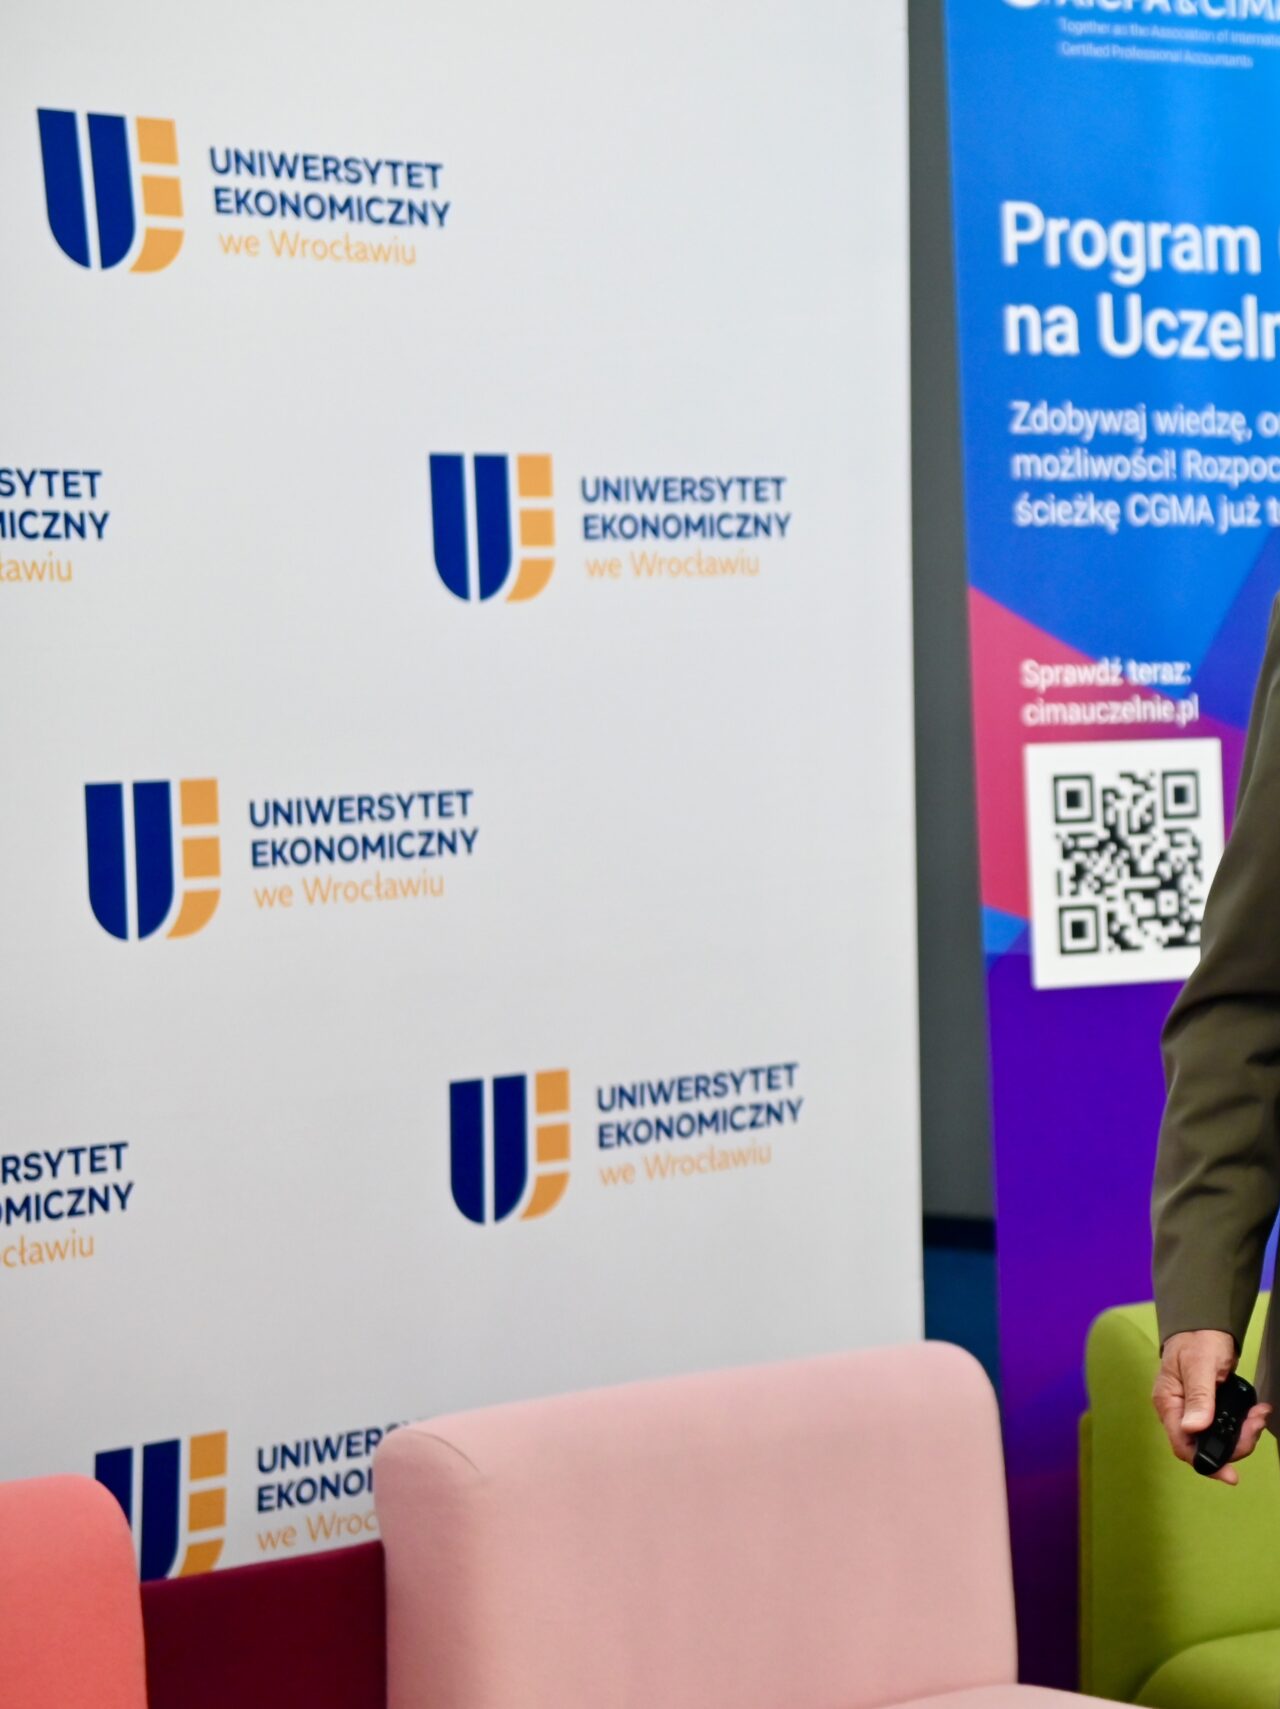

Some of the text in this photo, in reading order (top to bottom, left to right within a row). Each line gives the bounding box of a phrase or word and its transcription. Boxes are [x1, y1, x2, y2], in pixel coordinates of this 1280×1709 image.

[209, 146, 443, 190] UNIWERSYTET
[213, 186, 451, 228] EKONOMICZNY
[219, 230, 417, 266] we Wrocławiu
[1001, 200, 1262, 287] Program
[1003, 302, 1080, 356] na
[1009, 400, 1147, 443] Zdobywaj
[1153, 403, 1252, 444] wiedzę,
[1011, 447, 1176, 481] możliwości!
[580, 476, 786, 504] UNIWERSYTET
[582, 512, 792, 541] EKONOMICZNY
[1014, 492, 1121, 534] ścieżkę
[1127, 493, 1214, 526] CGMA
[1218, 494, 1261, 534] już
[585, 549, 760, 579] we Wrocławiu
[1020, 657, 1192, 692] Sprawdź teraz:
[1021, 694, 1200, 727] cimauczelnie.pl
[249, 790, 474, 828] UNIWERSYTET
[251, 828, 479, 868] EKONOMICZNY
[253, 869, 445, 909] we Wrocławiu
[596, 1062, 799, 1113] UNIWERSYTET
[597, 1097, 803, 1149] EKONOMICZNY
[1, 1141, 129, 1184] RSYTET
[599, 1139, 773, 1187] we Wrocławiu
[0, 1181, 134, 1226] MICZNY
[3, 1229, 94, 1268] cławiu
[257, 1526, 297, 1553] we
